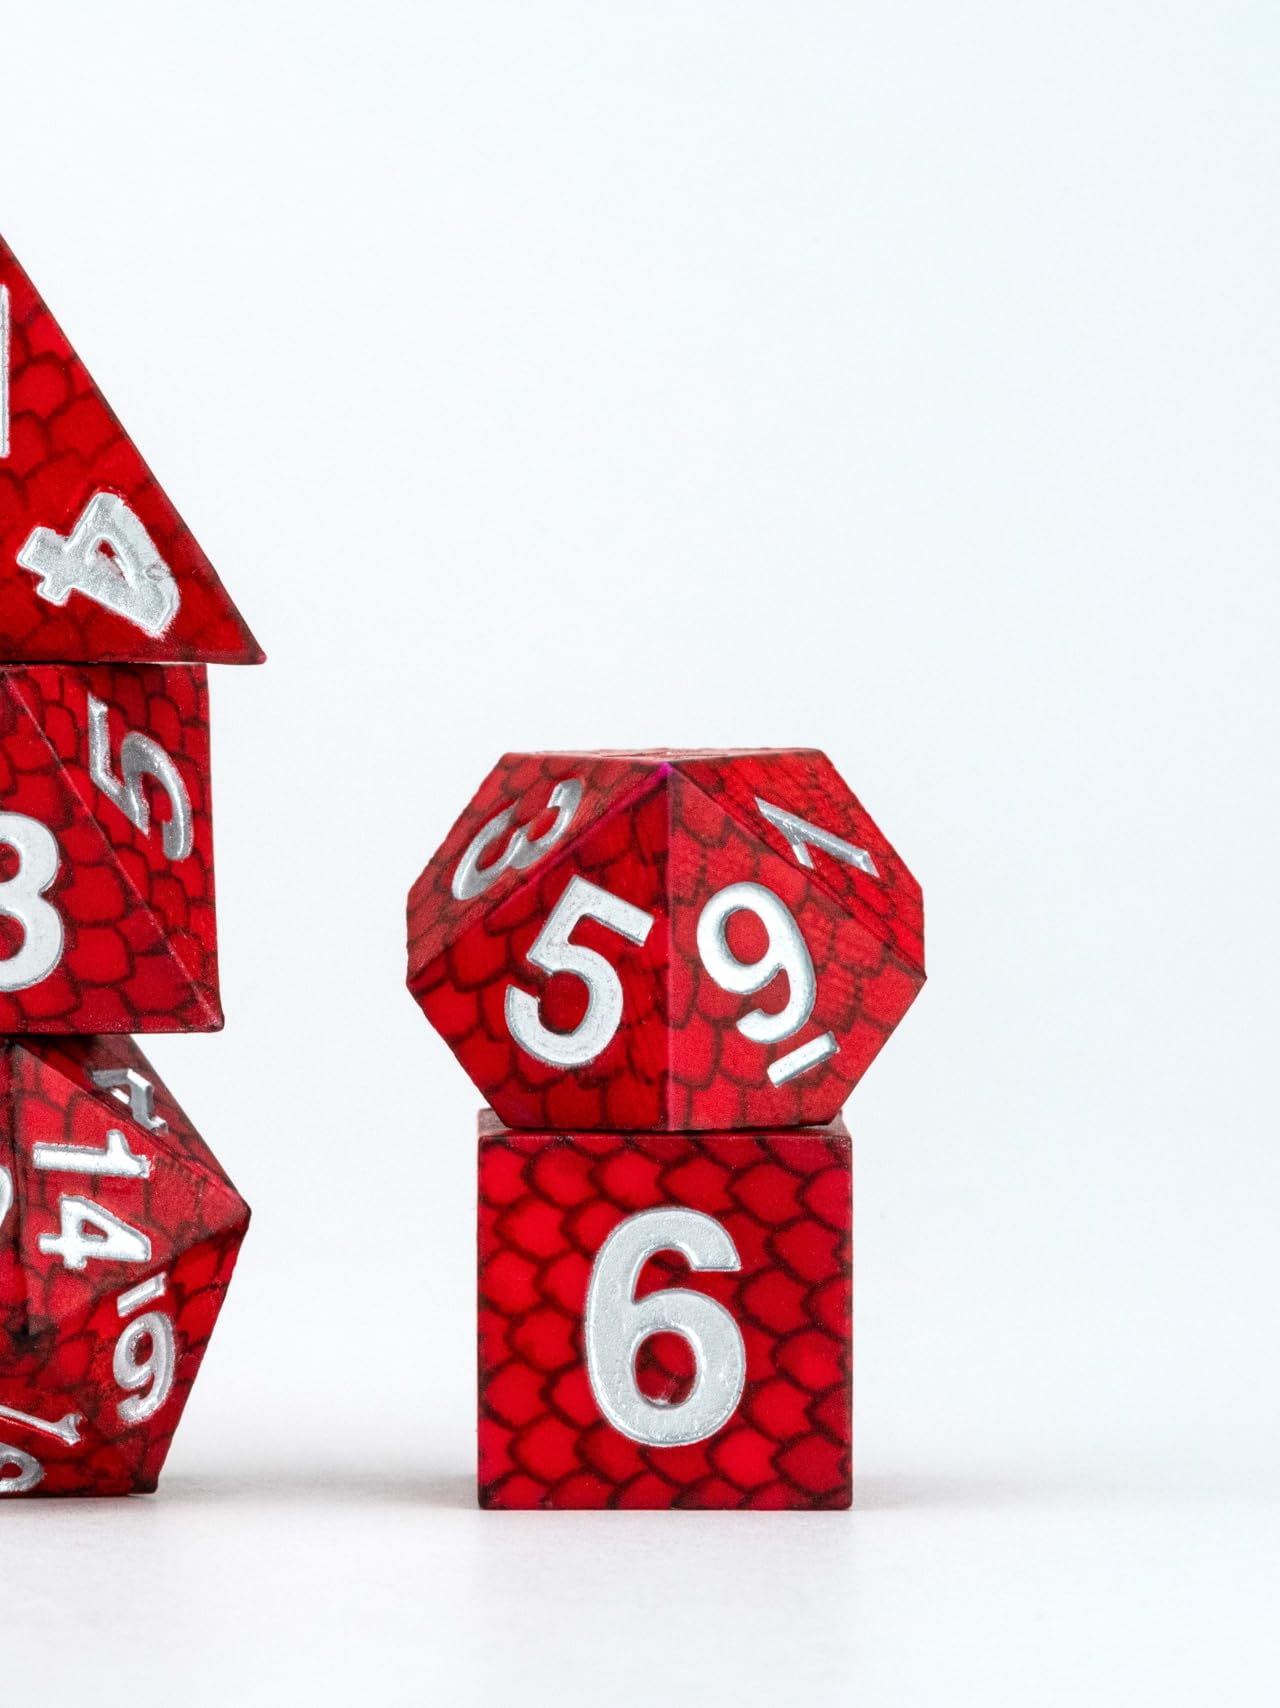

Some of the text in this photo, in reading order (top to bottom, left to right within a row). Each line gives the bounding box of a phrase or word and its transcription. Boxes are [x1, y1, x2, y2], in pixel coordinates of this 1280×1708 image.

[15, 490, 182, 640] 4
[86, 693, 194, 861] 5
[450, 778, 584, 902] 3
[503, 874, 655, 1070] 5
[695, 880, 818, 1046] 9
[30, 1128, 154, 1272] 14
[582, 1205, 748, 1449] 6
